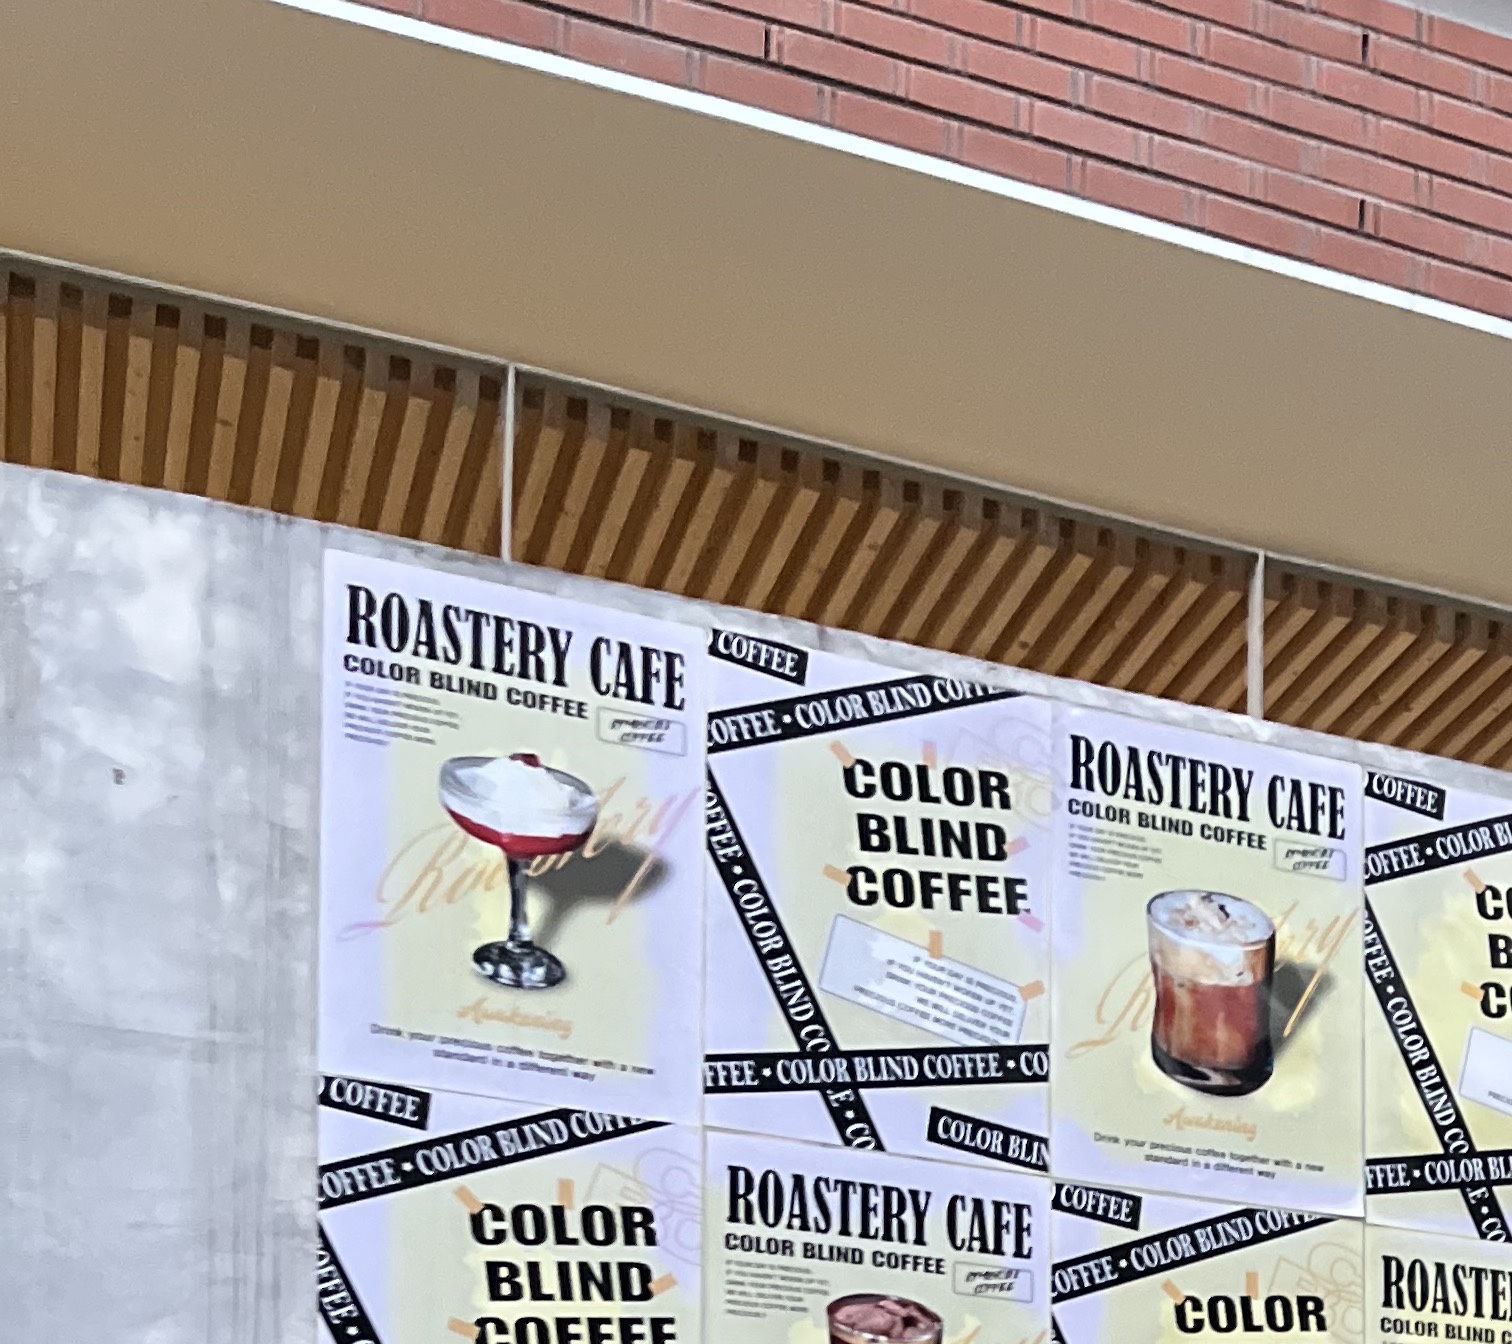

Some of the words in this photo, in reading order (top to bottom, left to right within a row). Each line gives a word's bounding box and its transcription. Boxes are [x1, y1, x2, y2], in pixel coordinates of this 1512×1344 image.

[346, 583, 573, 687] ROASTERY
[589, 636, 685, 711] CAFE
[717, 630, 799, 677] COFFEE
[343, 654, 420, 685] COLOR
[430, 671, 497, 700] BLIND
[506, 686, 587, 719] COFFEE
[794, 693, 870, 729] COLOR
[865, 682, 932, 716] BLIND
[843, 758, 1011, 810] COLOR
[1070, 734, 1254, 822] ROASTERY
[1267, 774, 1345, 840] CAFE
[1371, 773, 1438, 813] COFFEE
[856, 812, 1007, 862] BLIND
[1068, 798, 1130, 825] COLOR
[1138, 811, 1193, 836] BLIND
[1200, 823, 1266, 850] COFFEE
[1434, 826, 1497, 860] COLOR
[846, 865, 1029, 915] COFFEE
[732, 878, 784, 954] COLOR
[766, 953, 815, 1021] BLIND
[775, 1057, 851, 1085] COLOR
[851, 1055, 919, 1082] BLIND
[922, 1052, 1004, 1079] COFFEE
[1386, 996, 1430, 1065] COLOR
[1415, 1064, 1455, 1126] BLIND
[329, 1077, 420, 1121] COFFEE
[415, 1134, 500, 1176] COLOR
[494, 1117, 569, 1157] BLIND
[936, 1115, 1005, 1154] COLOR
[1423, 1157, 1486, 1184] COLOR
[470, 1203, 657, 1246] COLOR
[727, 1164, 932, 1246] ROASTERY
[946, 1194, 1032, 1259] CAFE
[1058, 1183, 1133, 1222] COFFEE
[724, 1232, 794, 1257] COLOR
[803, 1241, 864, 1265] BLIND
[872, 1250, 945, 1275] COFFEE
[1129, 1232, 1198, 1271] COLOR
[1193, 1216, 1254, 1253] BLIND
[485, 1260, 653, 1302] BLIND
[1174, 1294, 1327, 1333] COLOR
[1381, 1316, 1438, 1338] COLOR
[1444, 1323, 1494, 1344] BLIND
